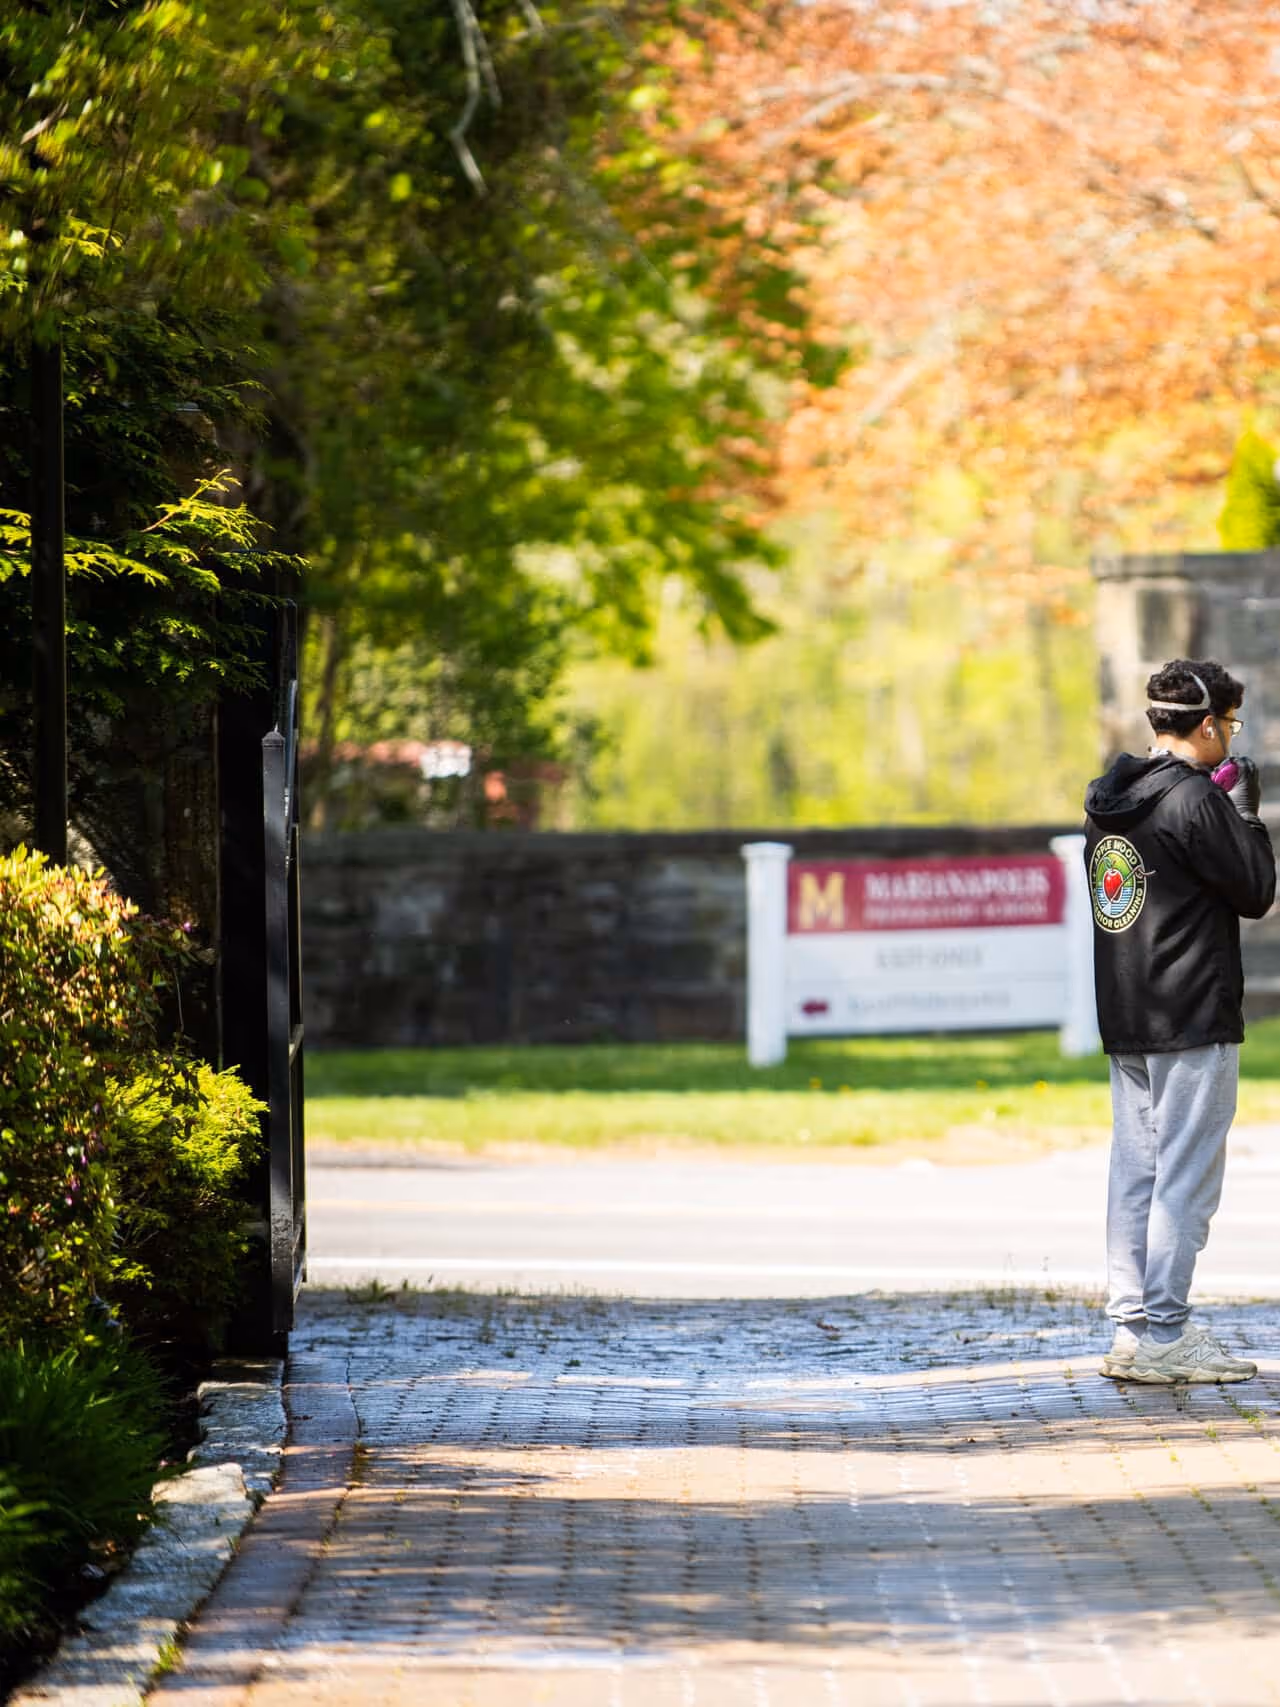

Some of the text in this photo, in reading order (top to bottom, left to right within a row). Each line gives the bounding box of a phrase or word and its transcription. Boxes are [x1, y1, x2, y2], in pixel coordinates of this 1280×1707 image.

[1094, 839, 1138, 865] APPLE WOOD
[798, 871, 845, 929] M
[1113, 887, 1143, 929] CLEANING
